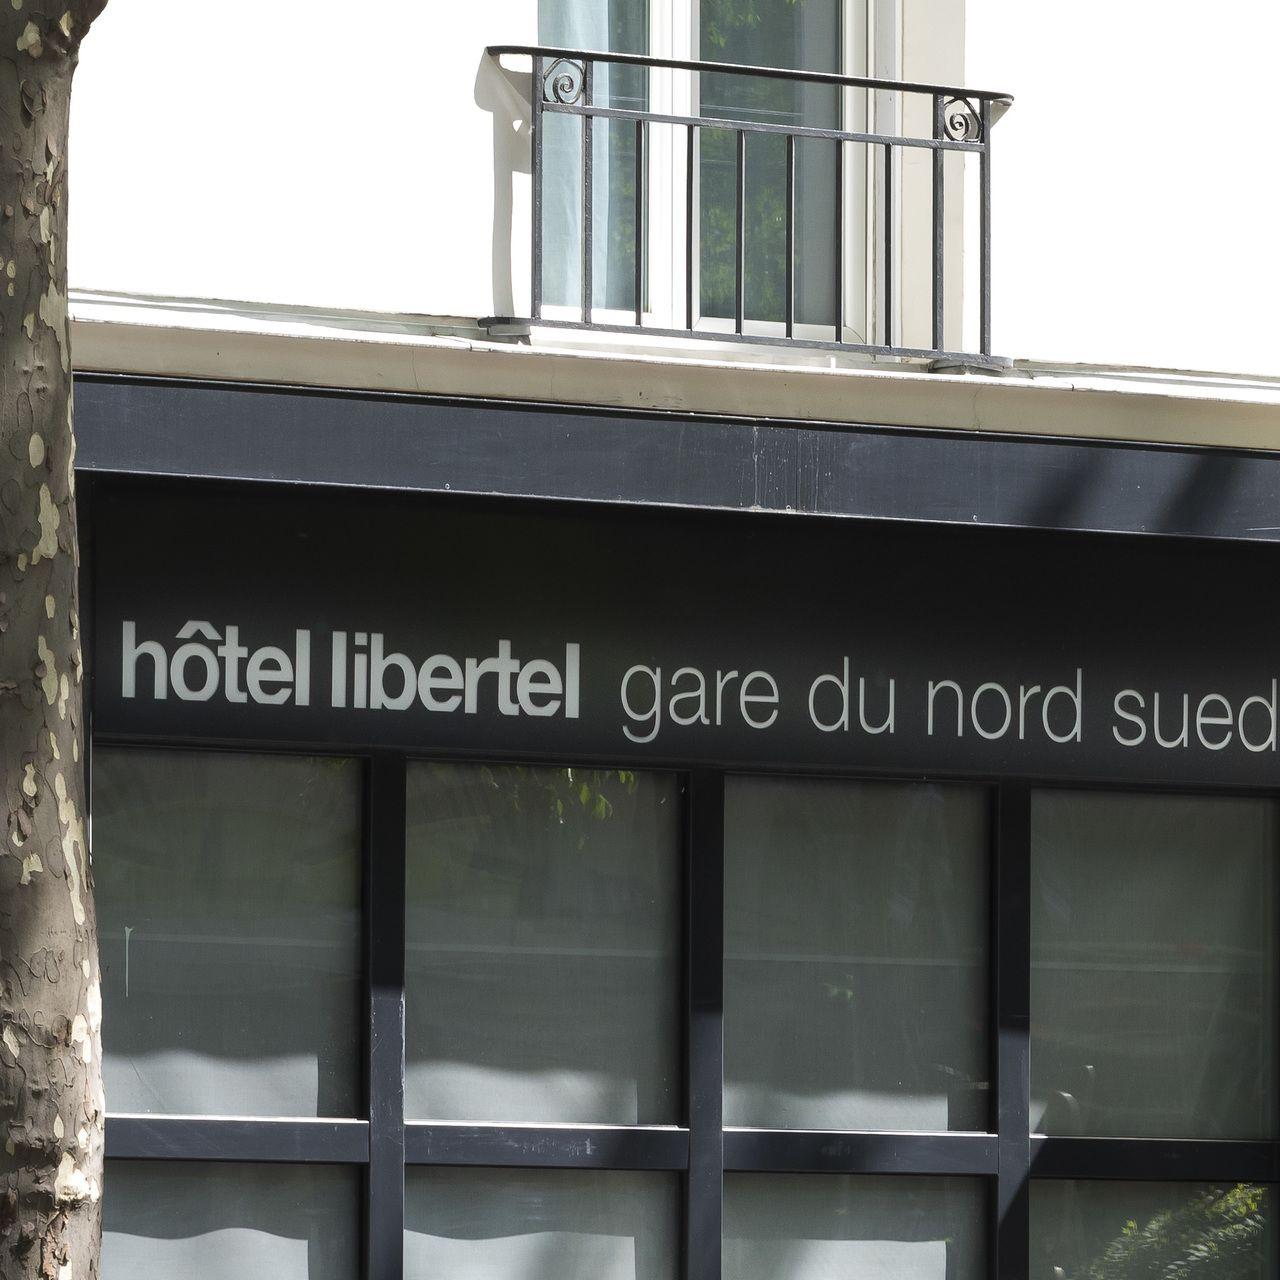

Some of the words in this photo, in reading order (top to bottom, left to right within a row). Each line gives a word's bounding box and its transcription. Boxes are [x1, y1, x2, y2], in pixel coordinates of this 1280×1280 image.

[121, 620, 311, 706] hôtel
[331, 630, 580, 719] libertel
[620, 664, 780, 744] gare
[808, 656, 895, 735] du
[927, 668, 1082, 743] nord
